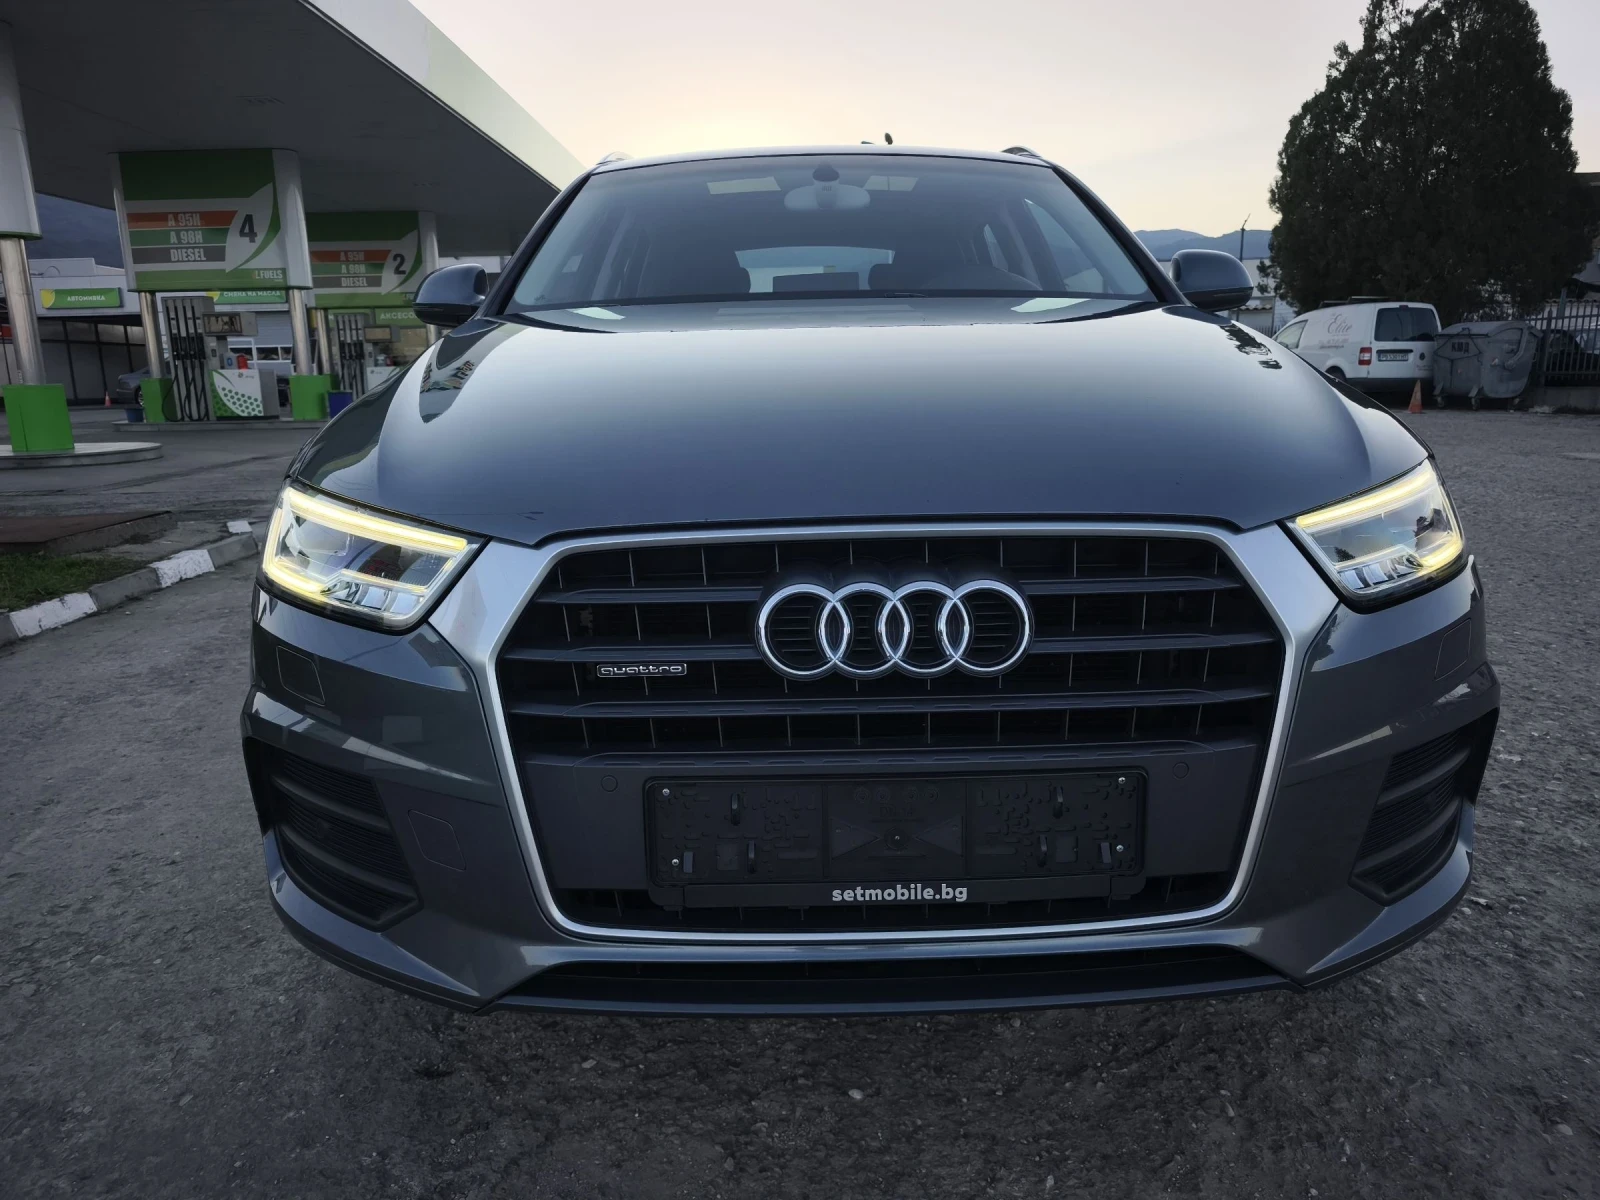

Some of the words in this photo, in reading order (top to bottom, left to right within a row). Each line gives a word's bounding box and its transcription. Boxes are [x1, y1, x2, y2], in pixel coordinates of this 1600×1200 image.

[239, 214, 258, 243] 4
[170, 248, 207, 262] DIESEL
[392, 253, 407, 275] 2
[341, 277, 368, 287] DIESEL
[380, 312, 416, 320] АКСЕСО
[600, 665, 682, 676] quattro
[832, 884, 968, 902] setmobile.bg
